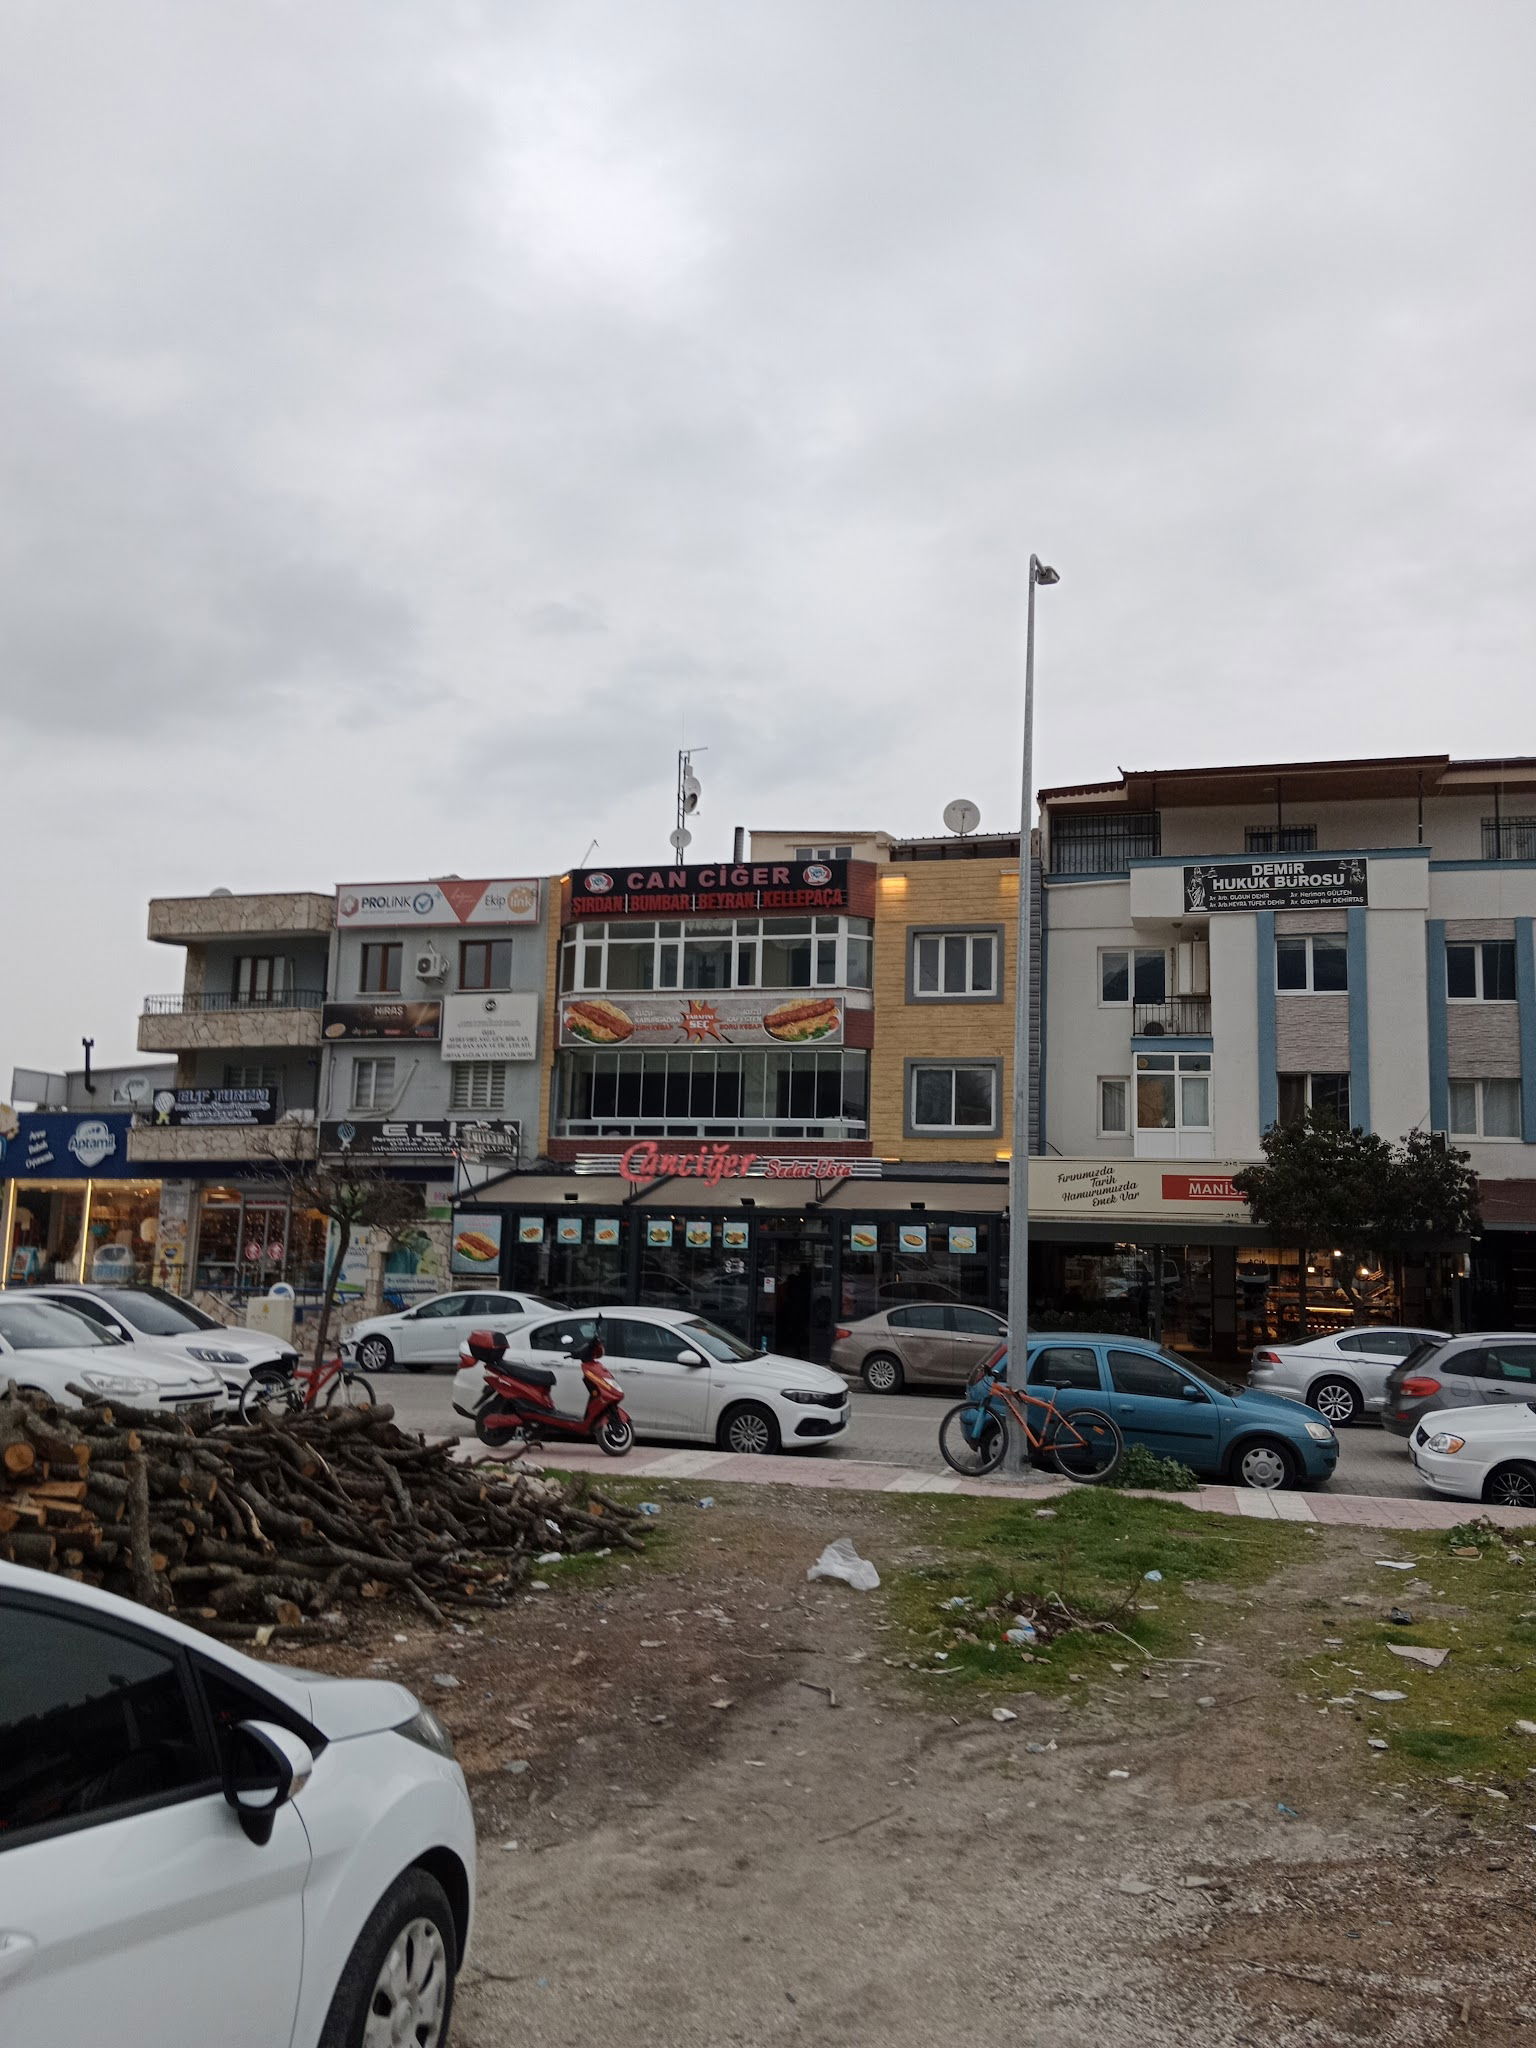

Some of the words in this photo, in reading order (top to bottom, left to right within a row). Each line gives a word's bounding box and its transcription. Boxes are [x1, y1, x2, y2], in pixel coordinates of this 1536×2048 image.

[626, 870, 688, 890] CAN
[699, 864, 790, 888] CİĞER
[1213, 876, 1270, 891] HUKUK
[1274, 873, 1345, 888] BÜROSU
[484, 895, 506, 907] Ekip
[630, 893, 690, 912] BUMBAR
[698, 891, 754, 910] BEYRAN
[763, 887, 843, 909] KELLEPAÇA
[689, 1020, 710, 1031] SEÇ
[70, 1136, 115, 1150] Aptamil
[619, 1141, 757, 1187] Canciğer
[764, 1159, 812, 1179] Sedat
[814, 1159, 853, 1178] Usta
[1057, 1165, 1114, 1184] Fırınımızda
[1090, 1175, 1118, 1188] Tarih
[1061, 1180, 1138, 1202] Hamurumuzda
[1092, 1194, 1118, 1207] Emek
[1119, 1191, 1140, 1202] Var
